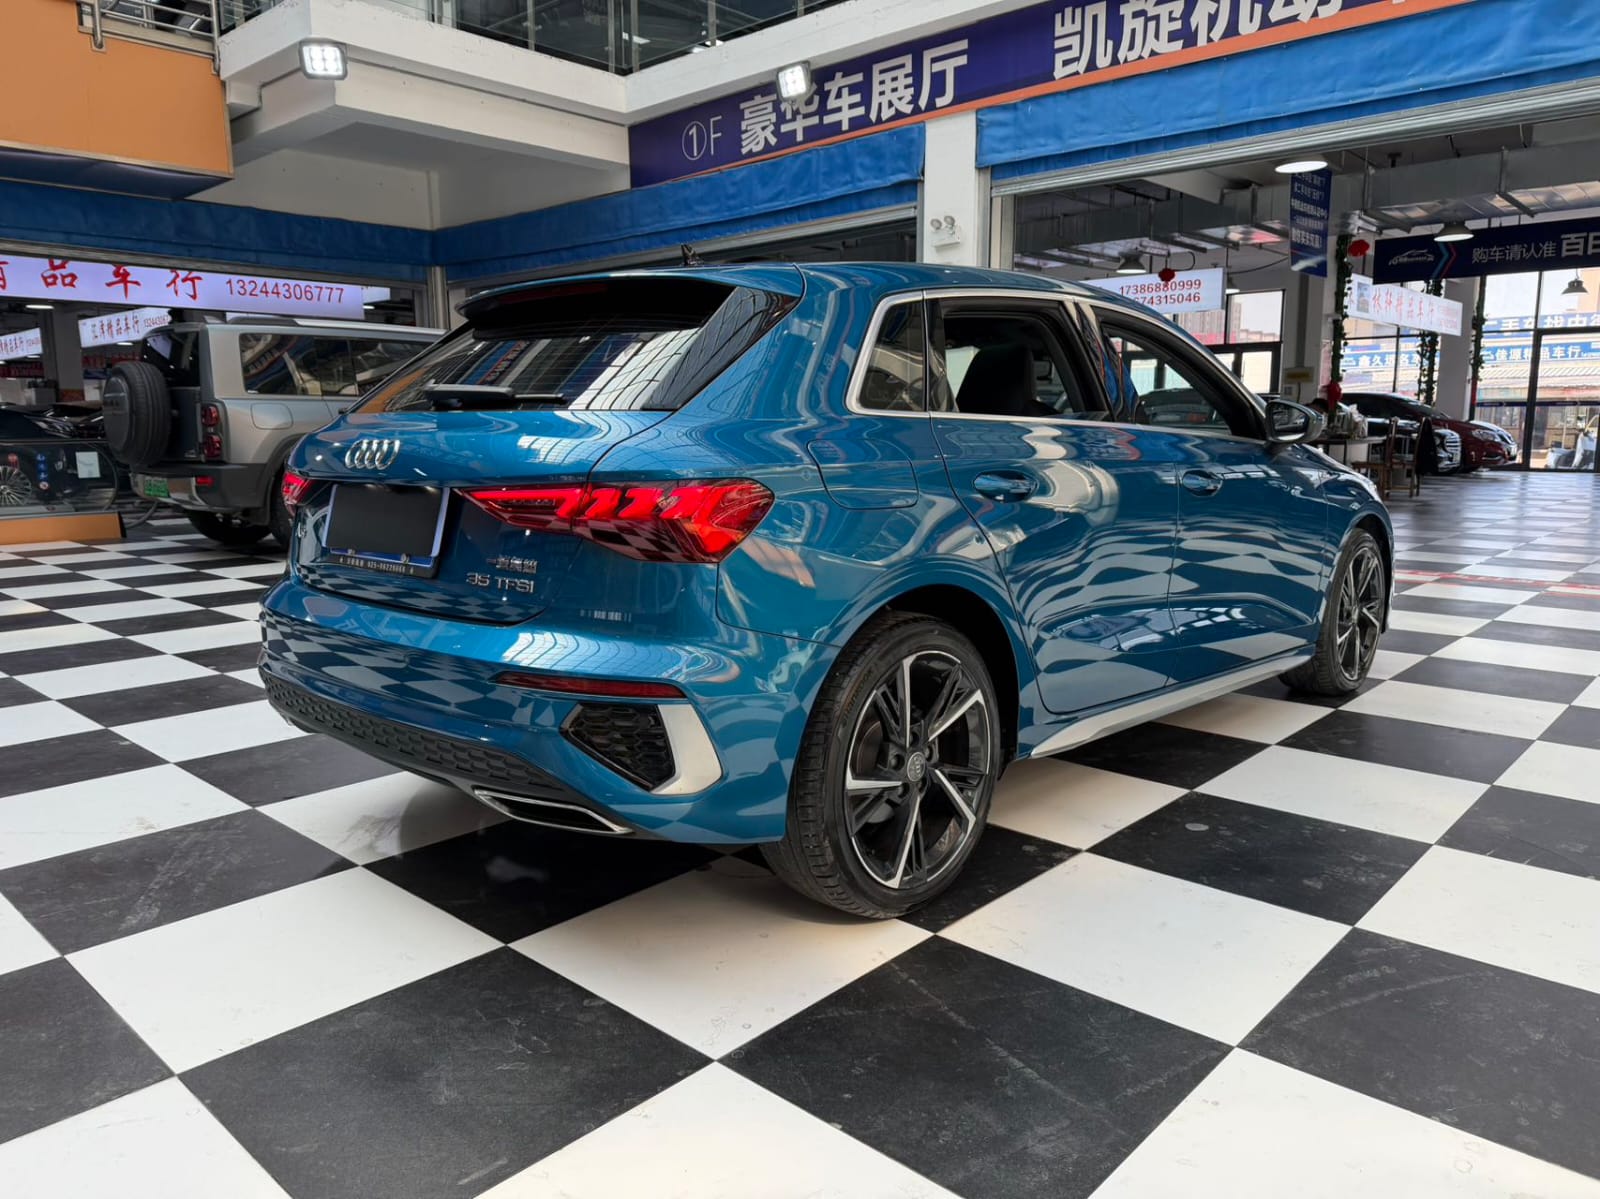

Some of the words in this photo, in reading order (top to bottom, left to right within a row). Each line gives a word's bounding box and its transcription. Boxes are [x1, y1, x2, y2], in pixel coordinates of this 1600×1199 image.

[739, 38, 969, 155] 豪华车展厅
[1471, 243, 1557, 264] 购车请认准
[226, 279, 344, 303] 13244306777
[1119, 279, 1202, 296] 17386880999
[1136, 292, 1201, 305] 74315046
[466, 571, 491, 587] 35
[494, 575, 535, 593] TFSI
